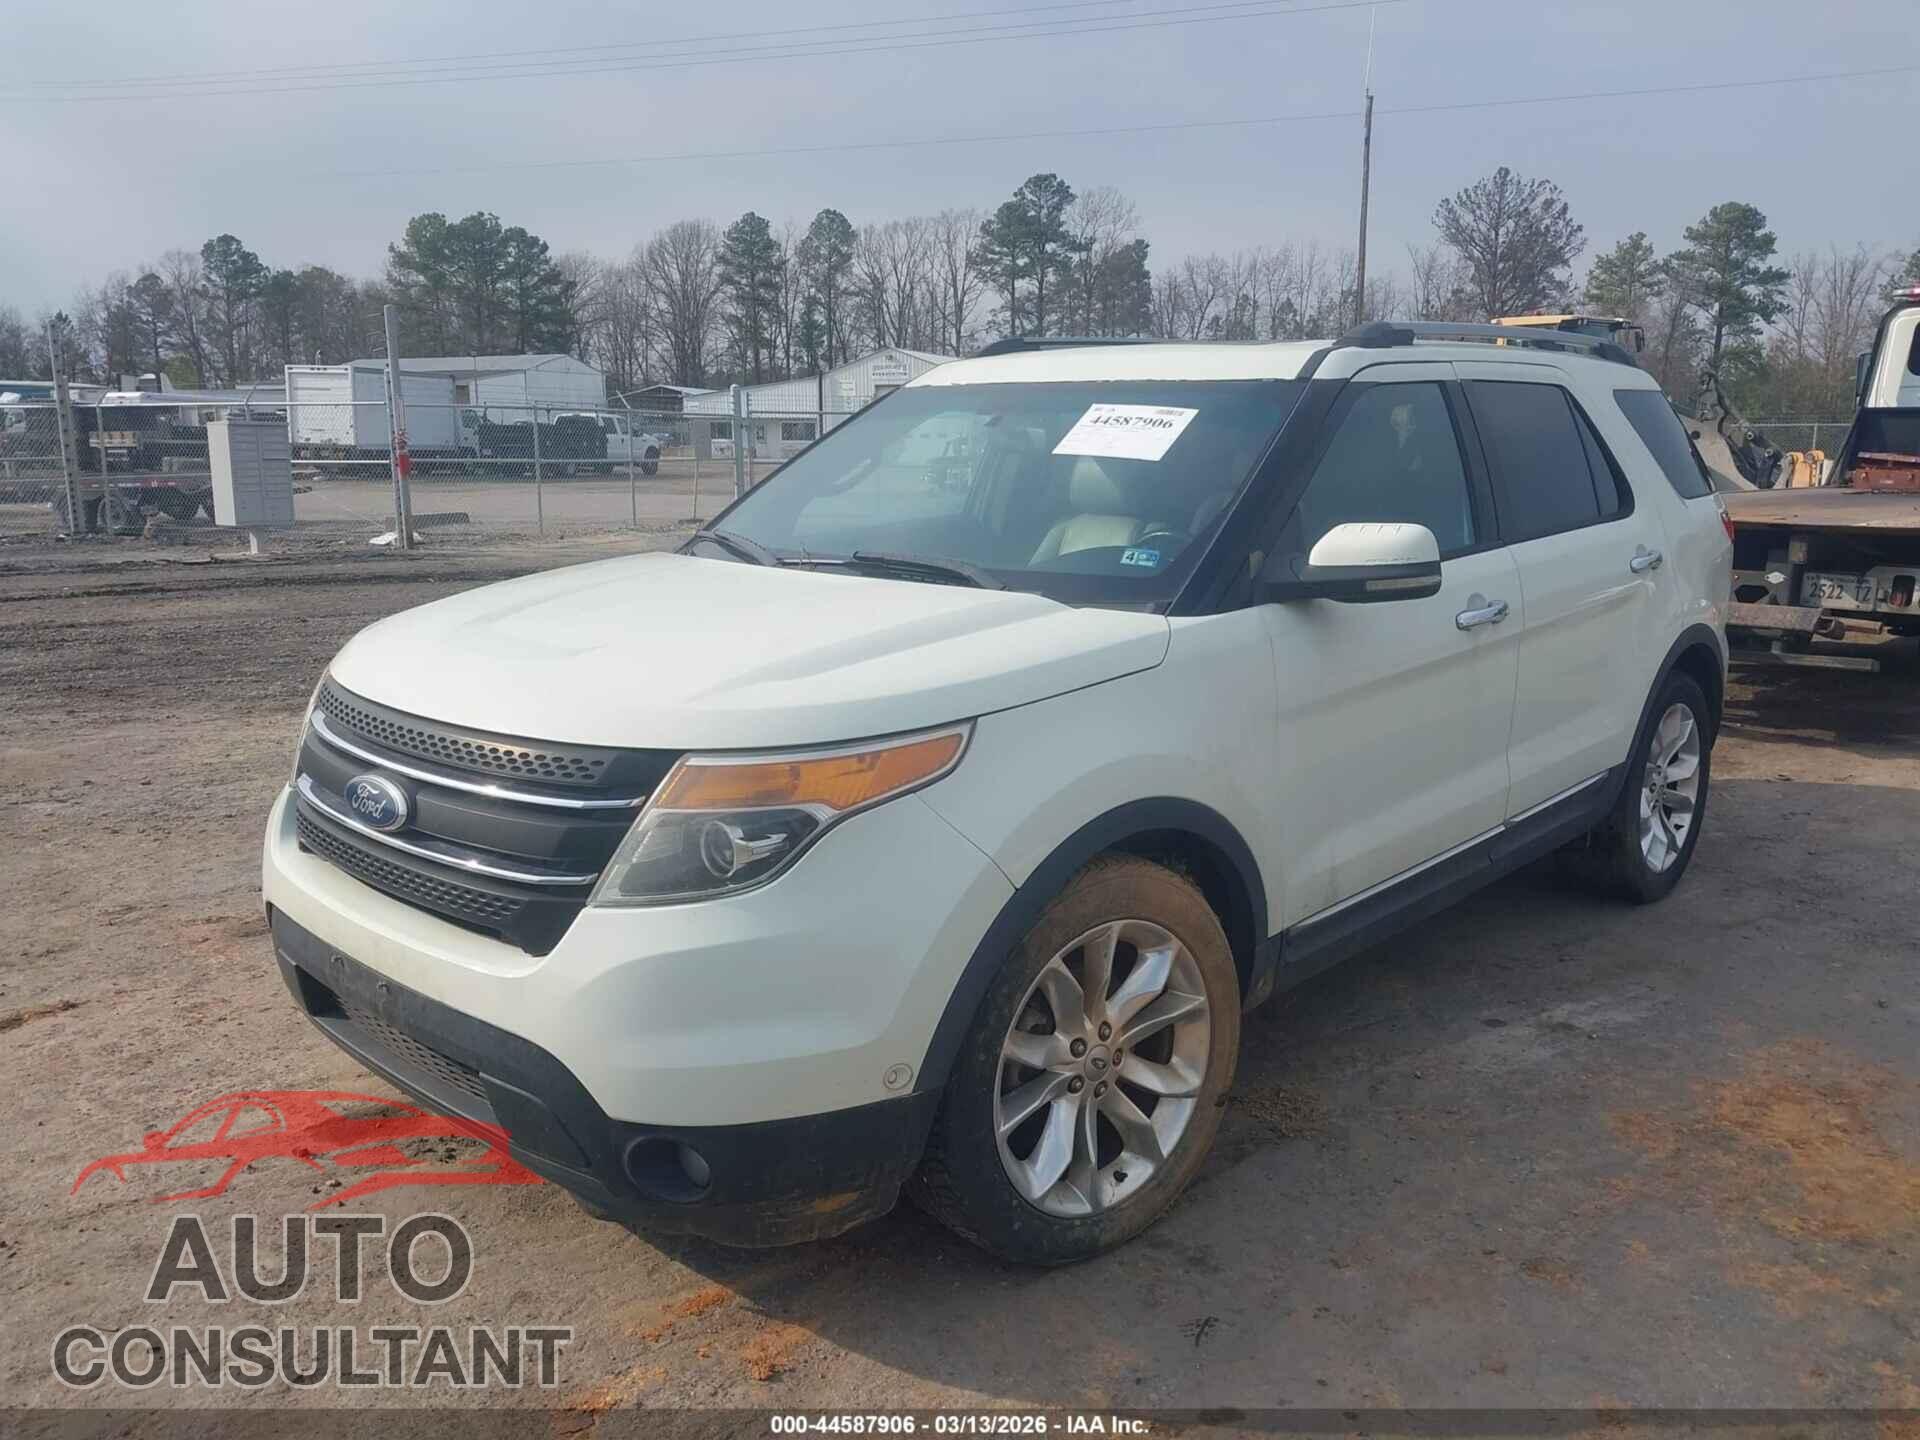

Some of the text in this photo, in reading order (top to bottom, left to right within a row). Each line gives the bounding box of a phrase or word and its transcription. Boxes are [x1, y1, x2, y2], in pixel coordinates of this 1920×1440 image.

[1089, 415, 1174, 429] 44587906
[1125, 551, 1135, 562] 4
[1809, 582, 1844, 600] 2522
[351, 783, 387, 819] Ford
